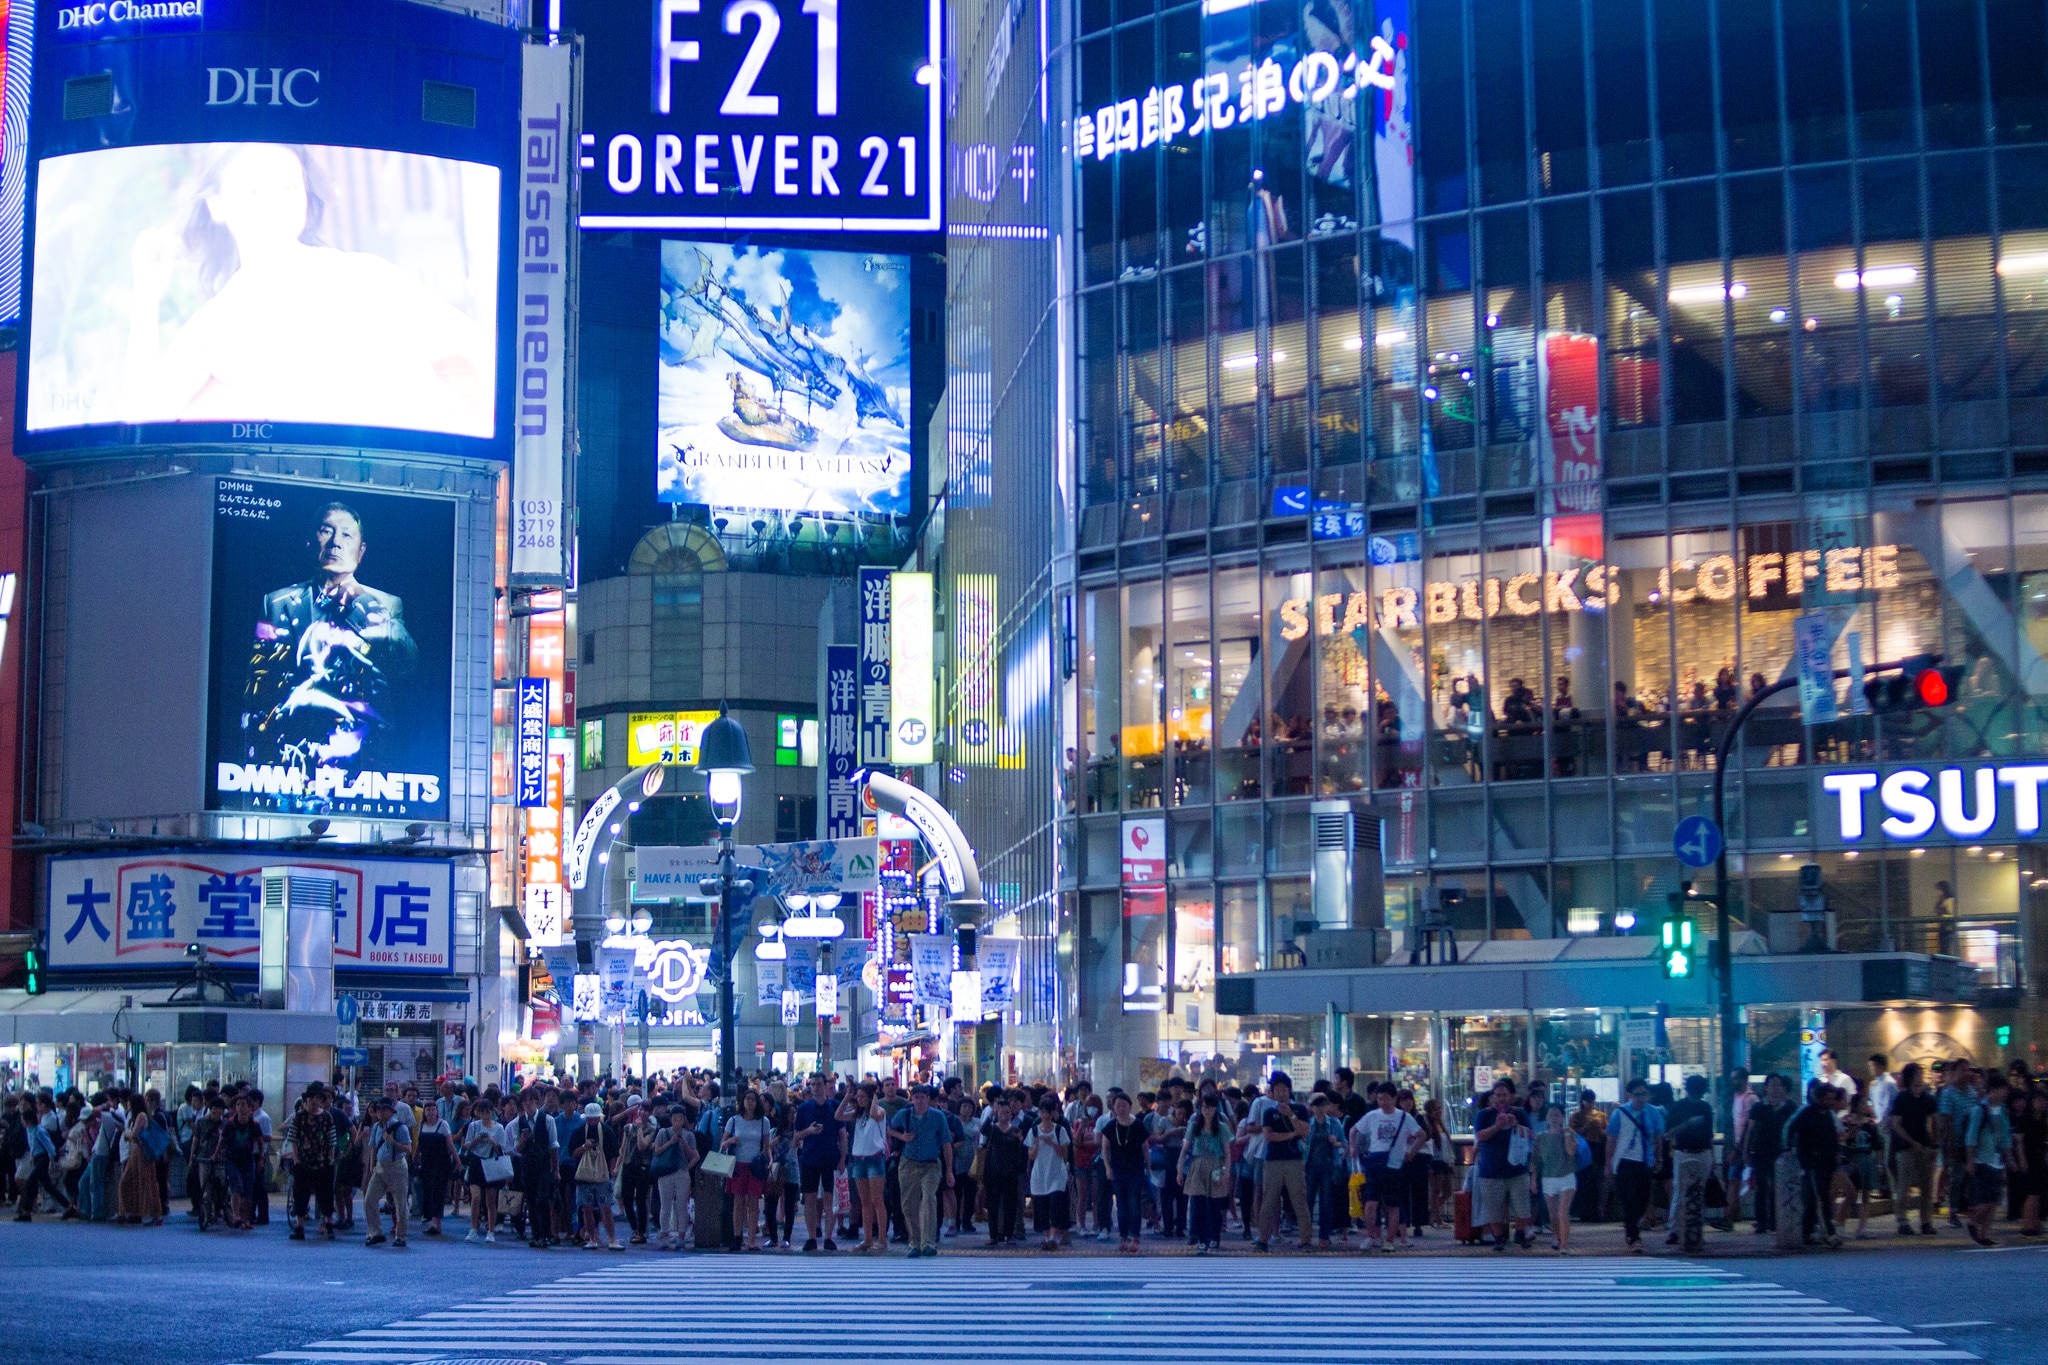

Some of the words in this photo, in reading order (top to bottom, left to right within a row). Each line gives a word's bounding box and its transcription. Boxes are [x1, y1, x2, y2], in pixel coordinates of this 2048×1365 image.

[58, 3, 105, 29] DHC
[109, 0, 204, 22] Channel
[656, 0, 838, 115] F21
[205, 67, 320, 107] DHC
[858, 135, 917, 197] 21
[524, 103, 561, 277] Taisei
[519, 293, 551, 436] neon
[231, 423, 274, 439] DHC
[218, 493, 282, 508] なんでこんなもの
[219, 480, 254, 492] DMMは
[217, 506, 271, 520] つくったんだ。
[521, 498, 553, 517] (03)
[517, 516, 556, 534] 3719
[517, 533, 556, 549] 2468
[1279, 564, 1622, 641] STARBUCKS
[1657, 543, 1899, 603] COFFEE
[862, 578, 890, 765] 洋服の青山
[521, 684, 544, 802] 大盛堂商事ビル
[898, 721, 926, 742] 4F
[828, 668, 857, 840] 洋服の青山
[217, 762, 302, 796] DMM
[315, 767, 441, 803] PLANETS
[252, 796, 282, 807] Art
[1822, 765, 2048, 841] TSUT
[644, 873, 671, 884] HAVE
[674, 873, 681, 884] A
[64, 872, 432, 948] 大盛堂店
[370, 952, 399, 963] BOOKS
[404, 953, 444, 964] TAISEIDO
